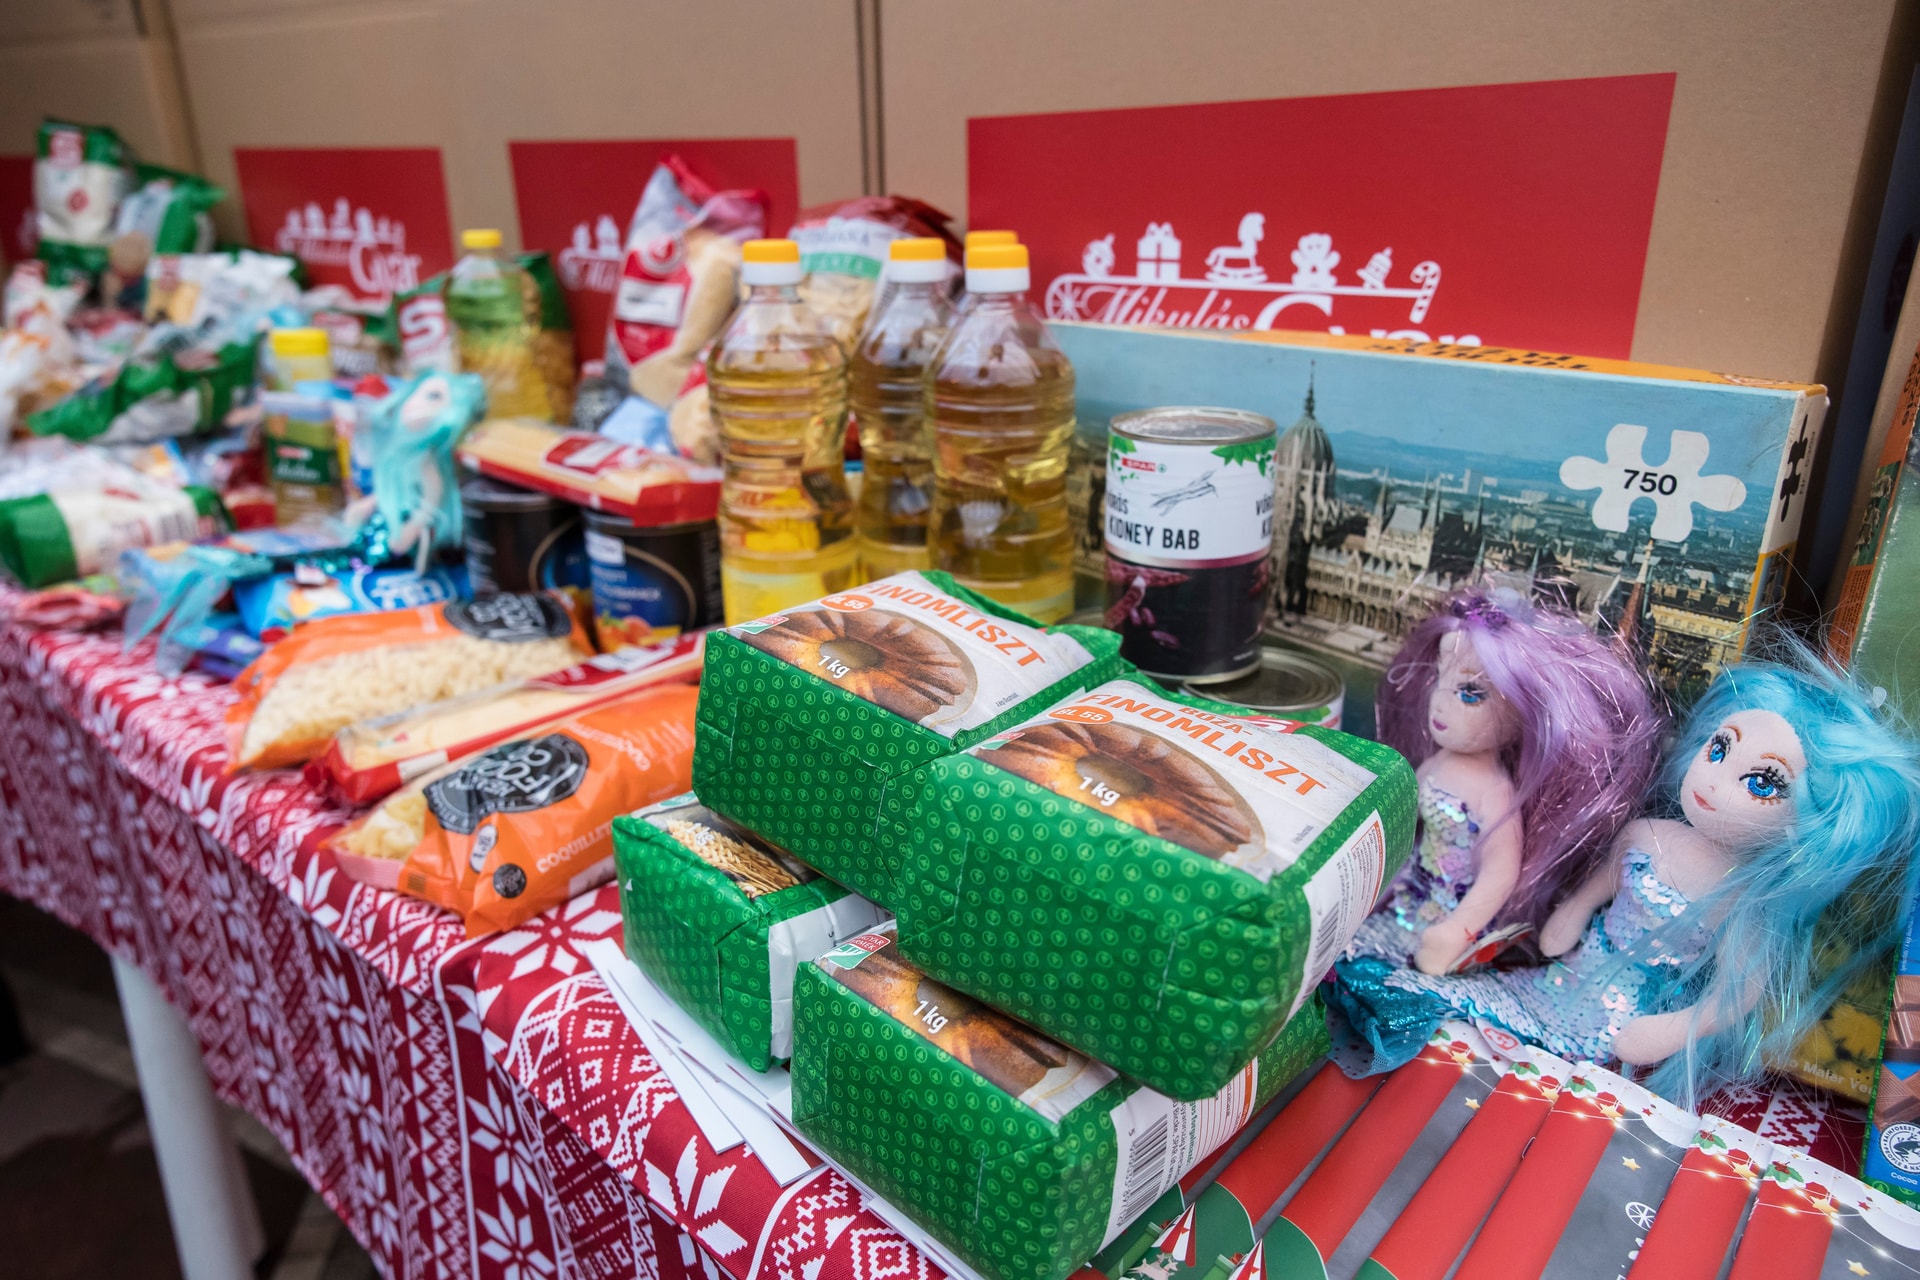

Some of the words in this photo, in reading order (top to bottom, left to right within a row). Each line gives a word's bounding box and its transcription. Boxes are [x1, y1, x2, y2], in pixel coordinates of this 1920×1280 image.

[1623, 468, 1677, 496] 750
[1108, 515, 1154, 547] KIDNEY
[1162, 528, 1200, 550] BAB
[847, 598, 866, 610] 55
[817, 654, 831, 667] 1
[827, 659, 850, 680] kg
[1079, 710, 1107, 722] 55
[1075, 693, 1327, 796] FINOMLISZT
[1079, 776, 1092, 790] 1
[1090, 781, 1121, 806] kg
[912, 999, 929, 1016] 1
[921, 1005, 949, 1034] kg
[1883, 1125, 1916, 1144] RAINFOREST
[1883, 1146, 1903, 1167] PEOPLE
[1890, 1171, 1918, 1185] Cocoa
